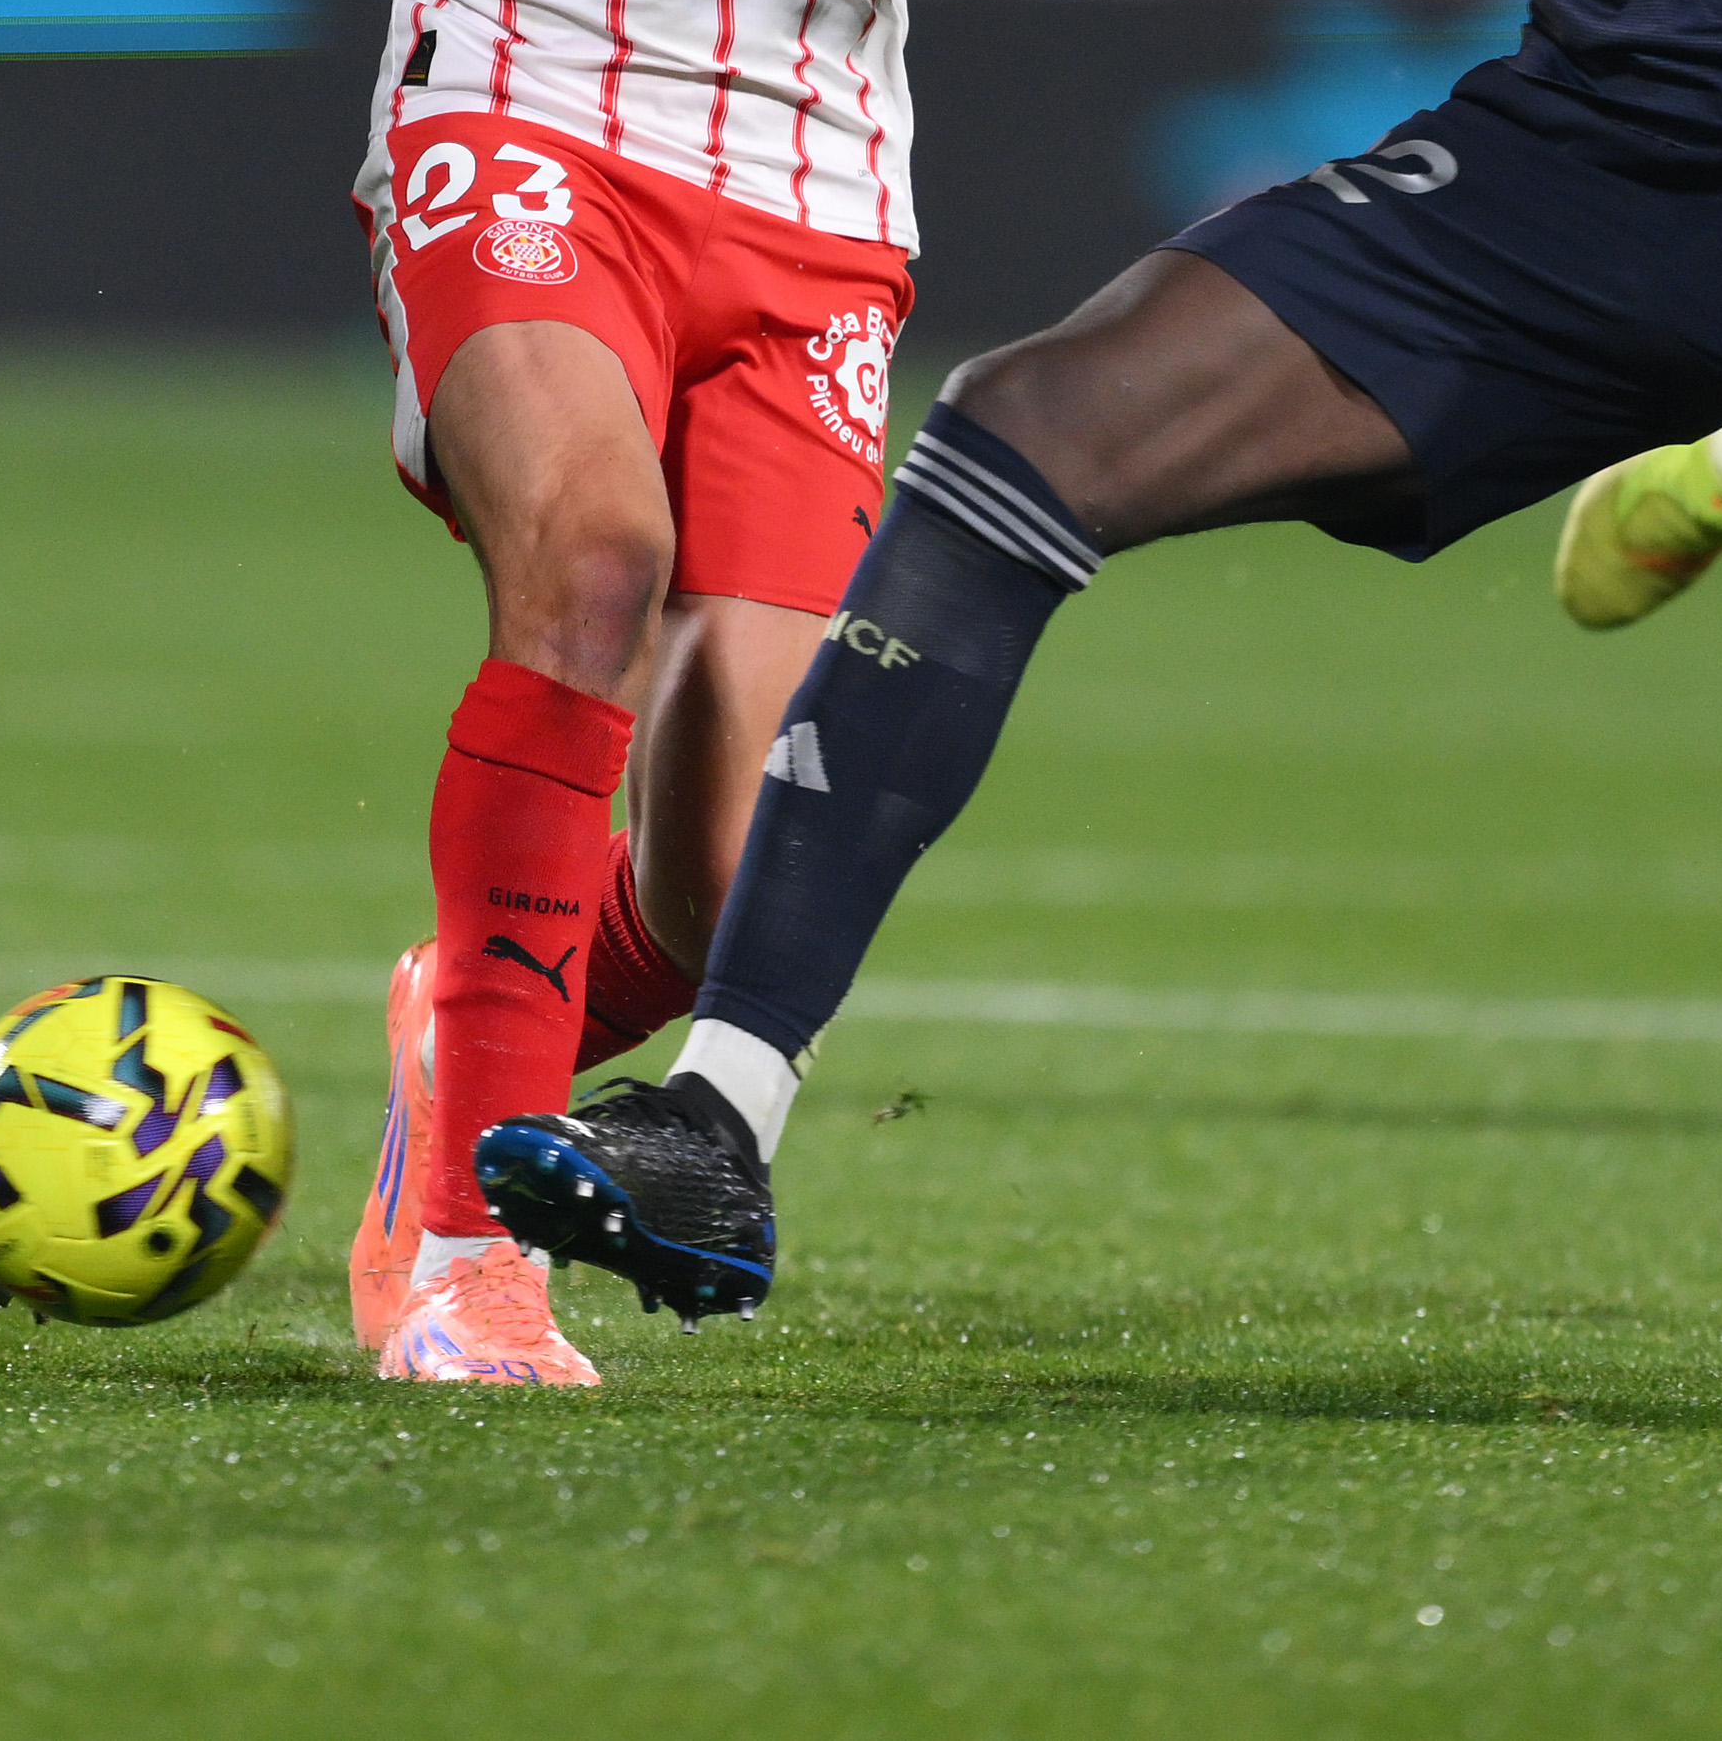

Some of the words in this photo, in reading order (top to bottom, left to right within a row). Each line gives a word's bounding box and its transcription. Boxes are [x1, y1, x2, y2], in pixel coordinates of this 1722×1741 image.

[401, 141, 574, 252] 23
[486, 222, 554, 239] GIRONA
[499, 266, 540, 280] FUTBOL
[806, 374, 863, 454] Pirineu
[489, 887, 580, 916] GIRONA
